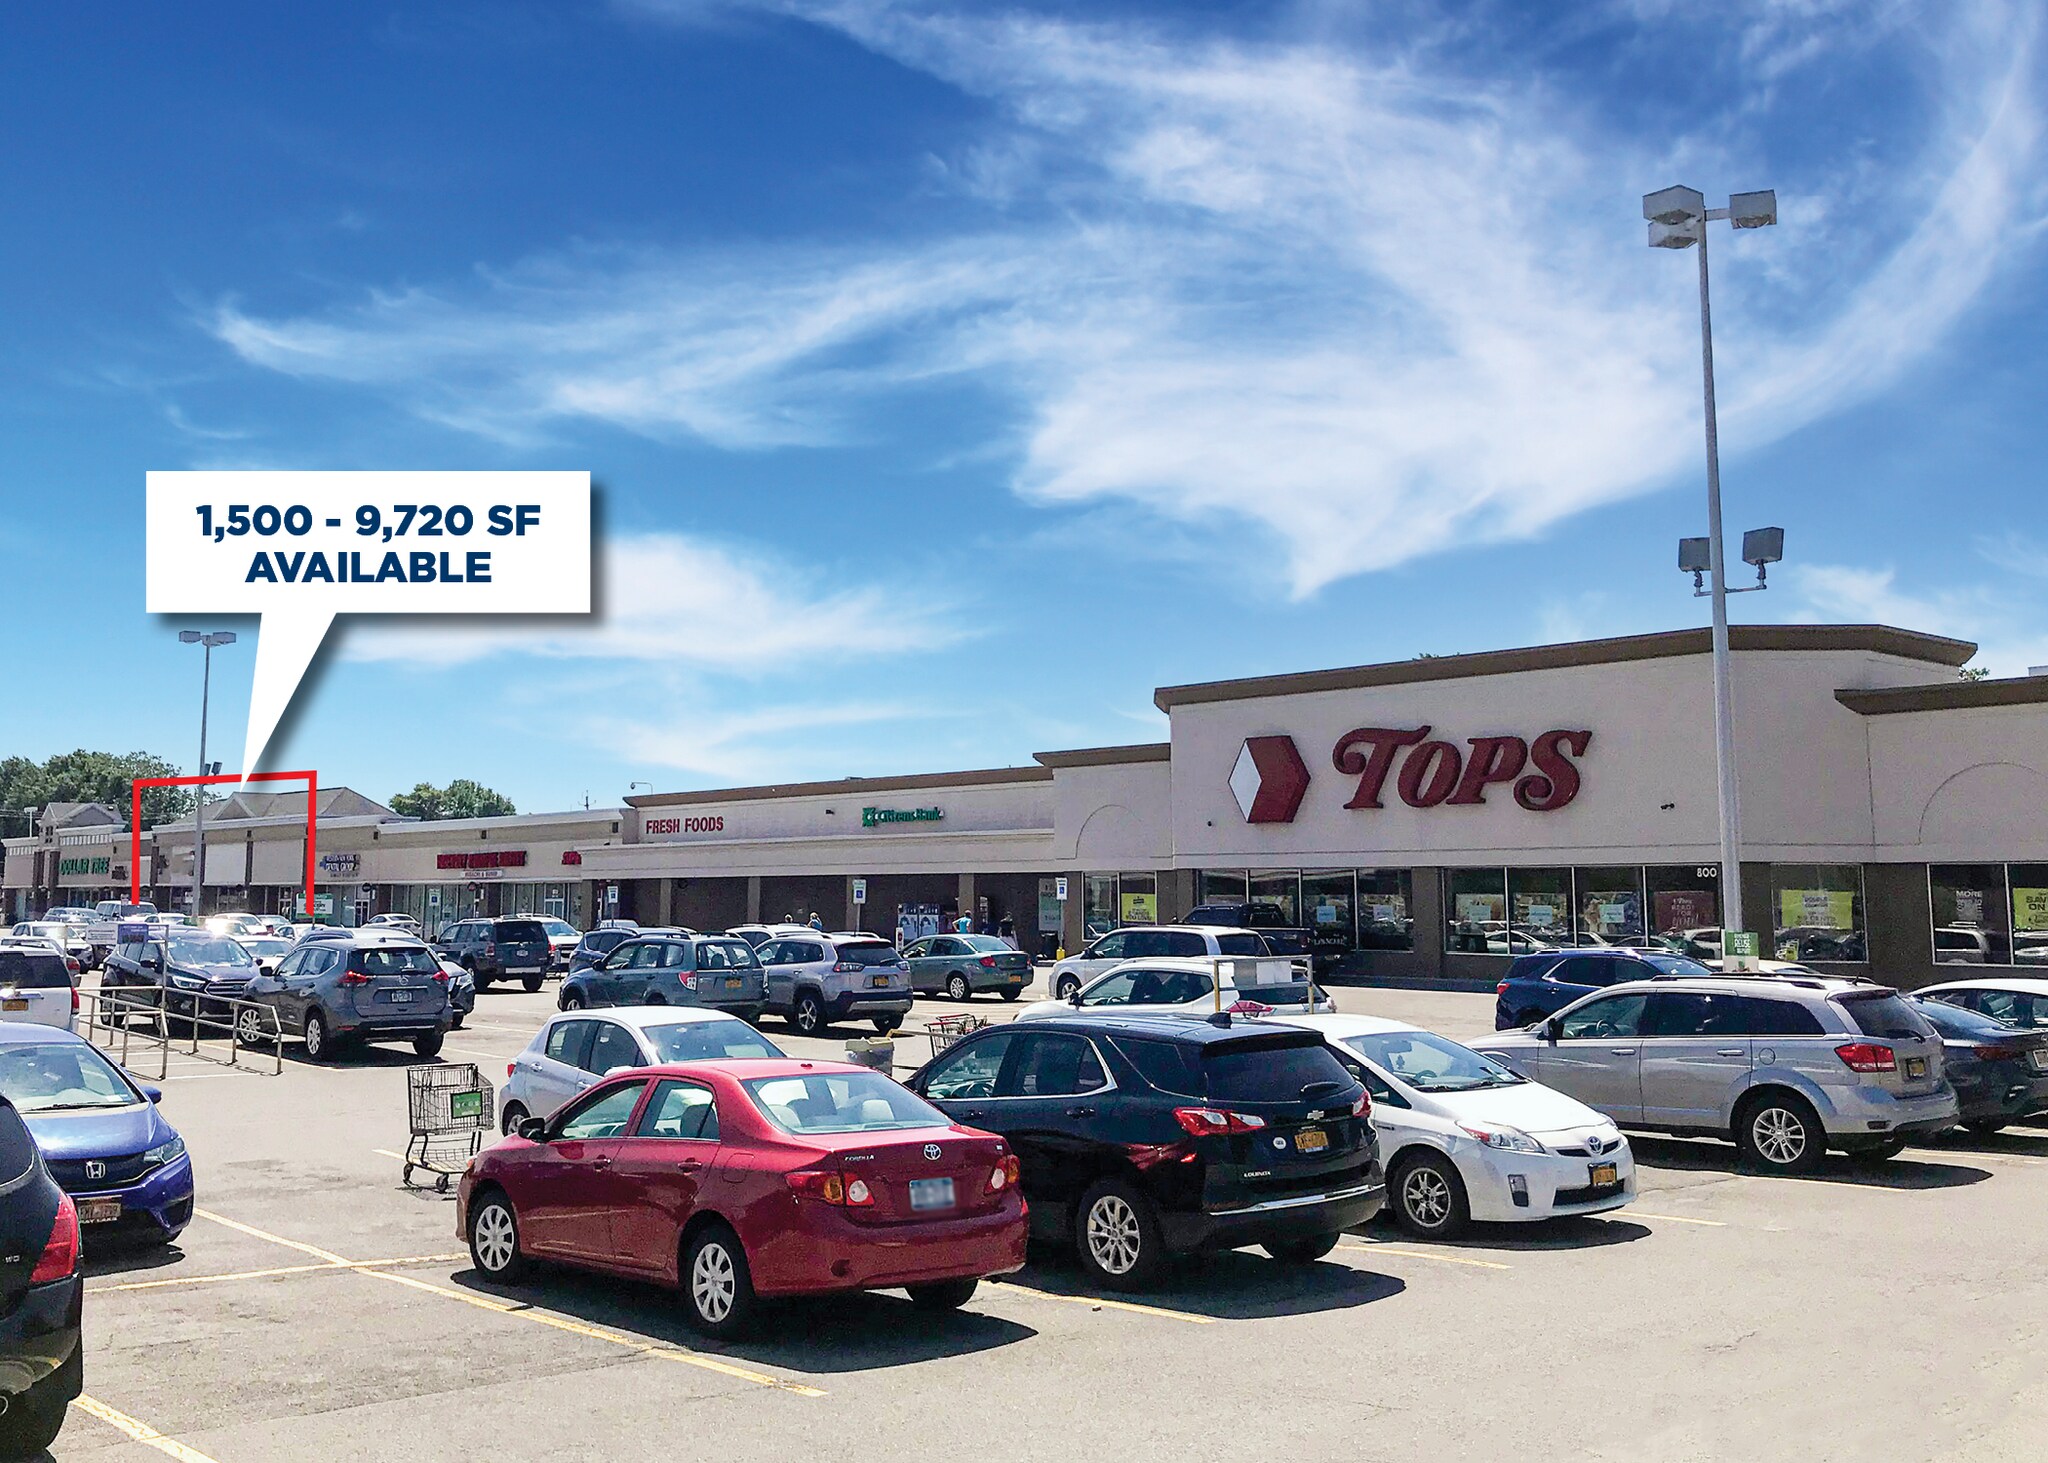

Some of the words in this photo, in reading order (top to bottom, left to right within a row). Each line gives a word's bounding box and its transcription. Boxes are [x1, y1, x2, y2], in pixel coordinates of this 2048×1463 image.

[1332, 725, 1592, 811] TOPS
[916, 806, 939, 821] Bank
[646, 819, 680, 834] FRESH
[684, 816, 724, 832] FOODS
[60, 858, 90, 875] DOLLAR
[91, 857, 110, 874] TREE
[1697, 868, 1717, 878] 800
[2028, 903, 2046, 911] ON
